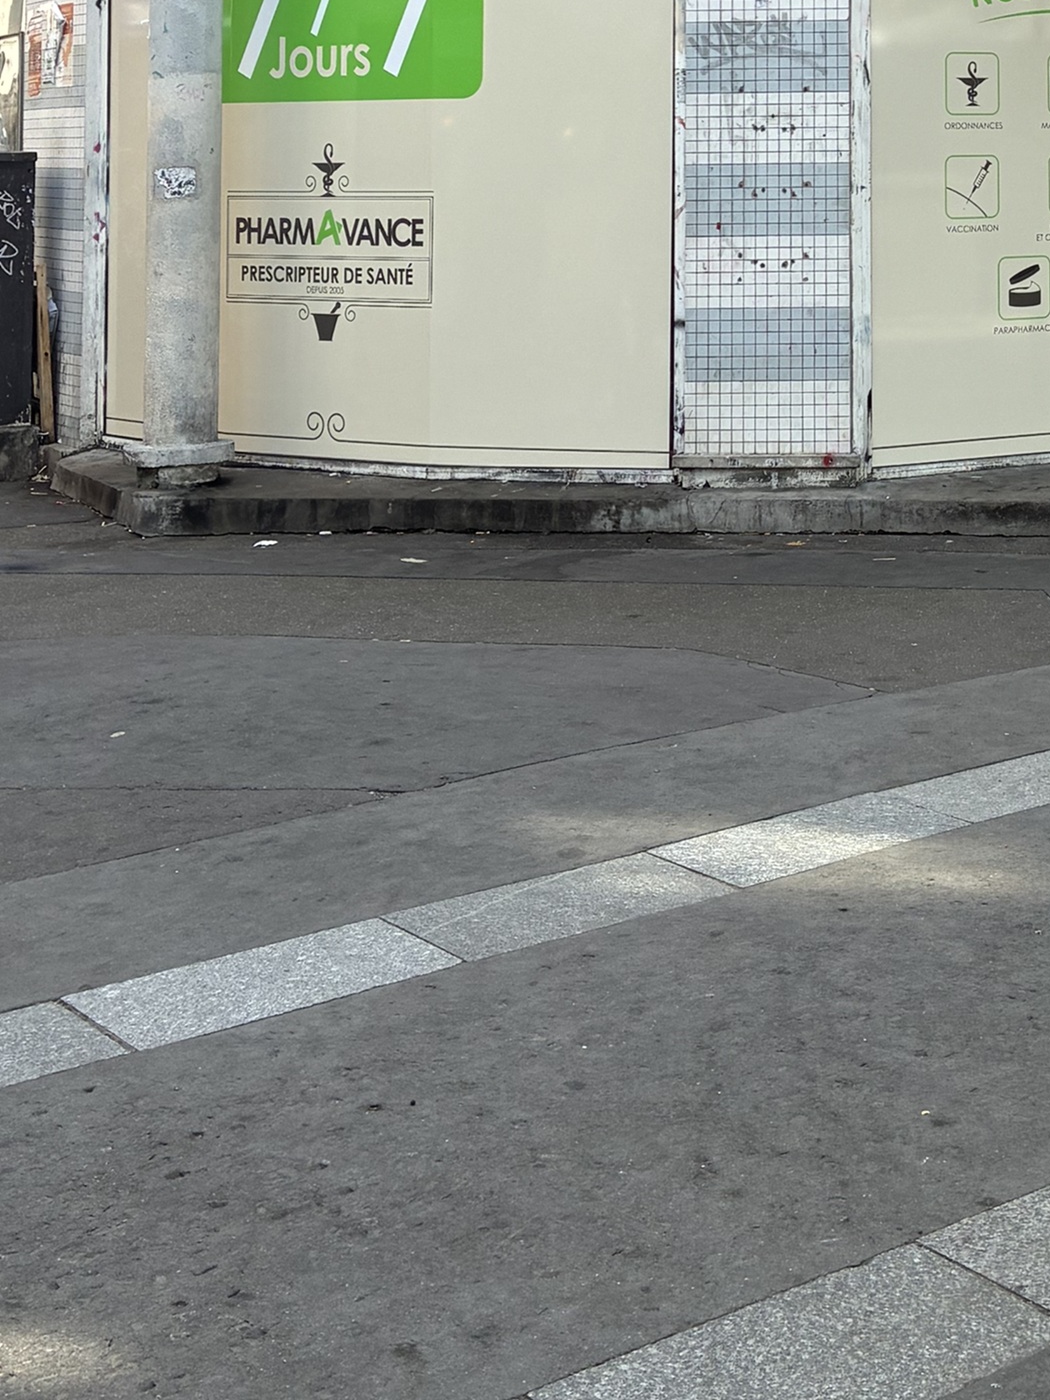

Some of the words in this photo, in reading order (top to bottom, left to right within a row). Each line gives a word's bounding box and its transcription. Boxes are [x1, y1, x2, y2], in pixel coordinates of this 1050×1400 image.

[268, 36, 372, 80] Jours
[943, 121, 1004, 131] ORDONNANCES
[946, 224, 1000, 234] VACCINATION
[1036, 233, 1044, 242] ET
[241, 265, 340, 284] PRESCRIPTEUR
[343, 267, 363, 285] DE
[366, 262, 414, 286] SANTÉ
[306, 285, 329, 295] DEPUIS
